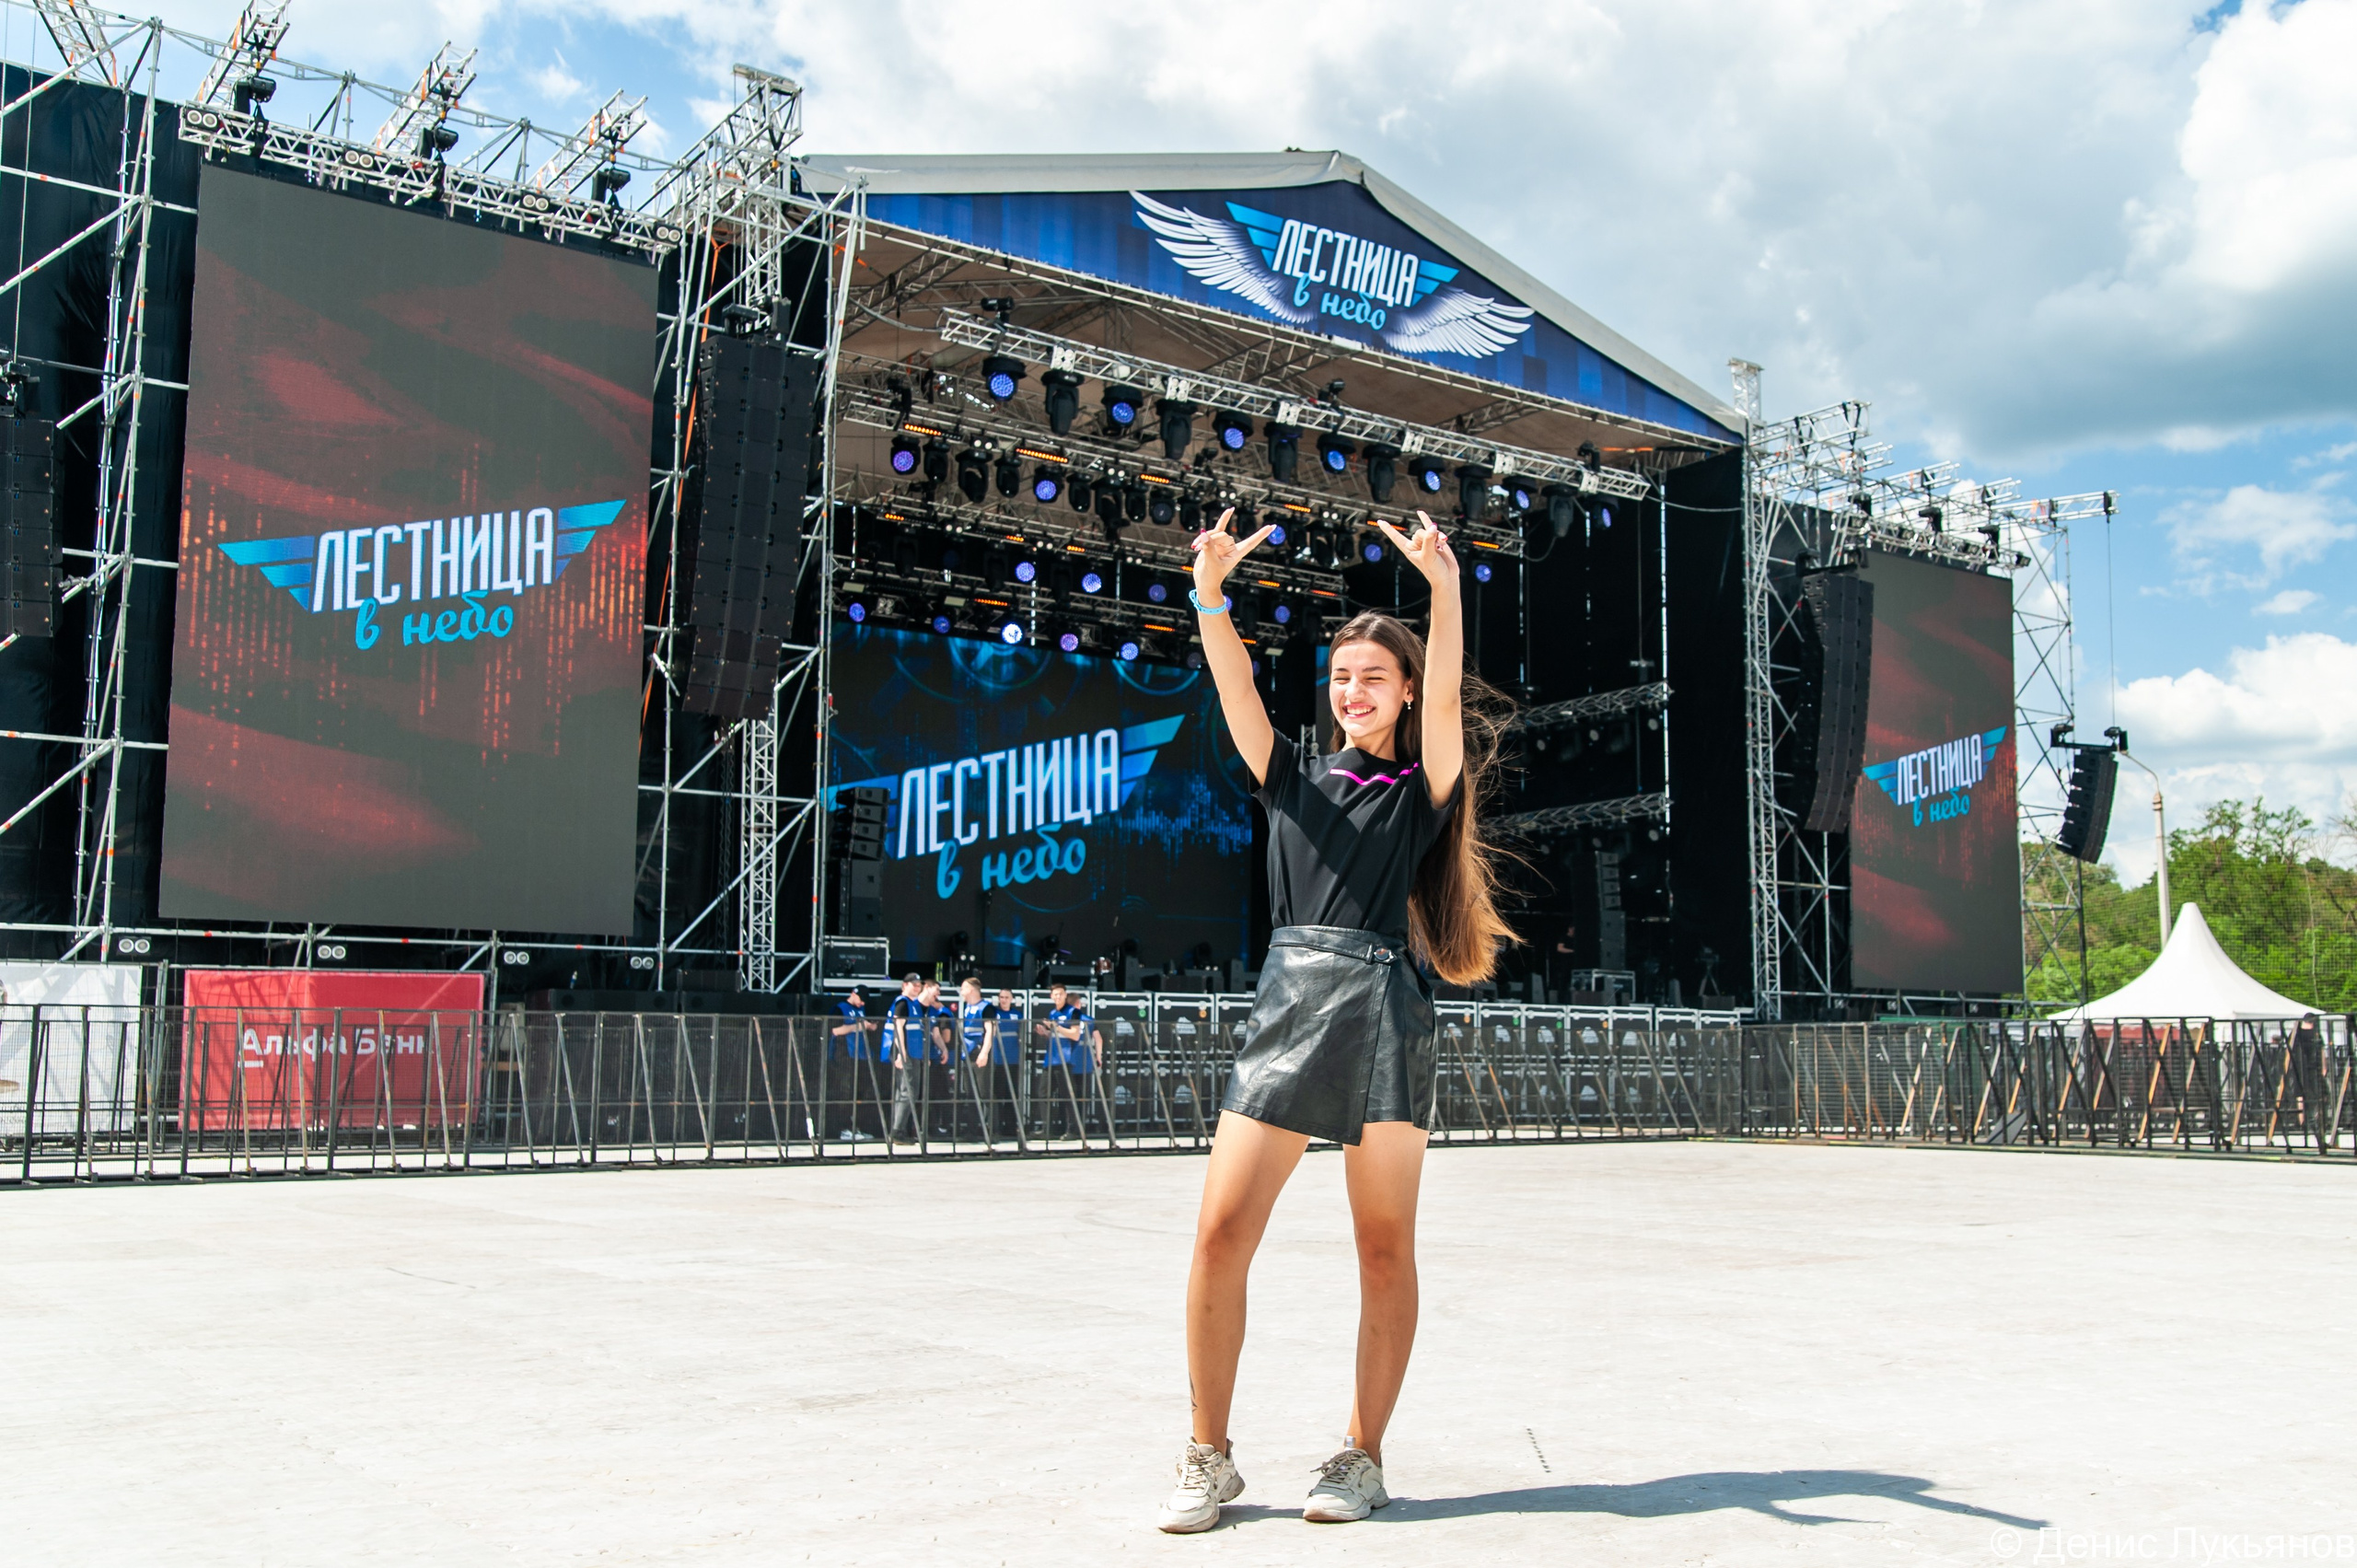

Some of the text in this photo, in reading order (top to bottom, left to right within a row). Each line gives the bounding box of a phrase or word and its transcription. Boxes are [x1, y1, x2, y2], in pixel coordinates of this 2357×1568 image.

[1272, 219, 1419, 308] ЛЕСТНИЦА
[1294, 273, 1387, 330] в небо
[312, 507, 553, 613] ЛЕСТНИЦА
[355, 590, 514, 650] в небо
[897, 728, 1120, 860] ЛЕСТНИЦА
[1897, 734, 1982, 806] ЛЕСТНИЦА
[1912, 786, 1970, 826] в небо
[936, 823, 1086, 900] в небо
